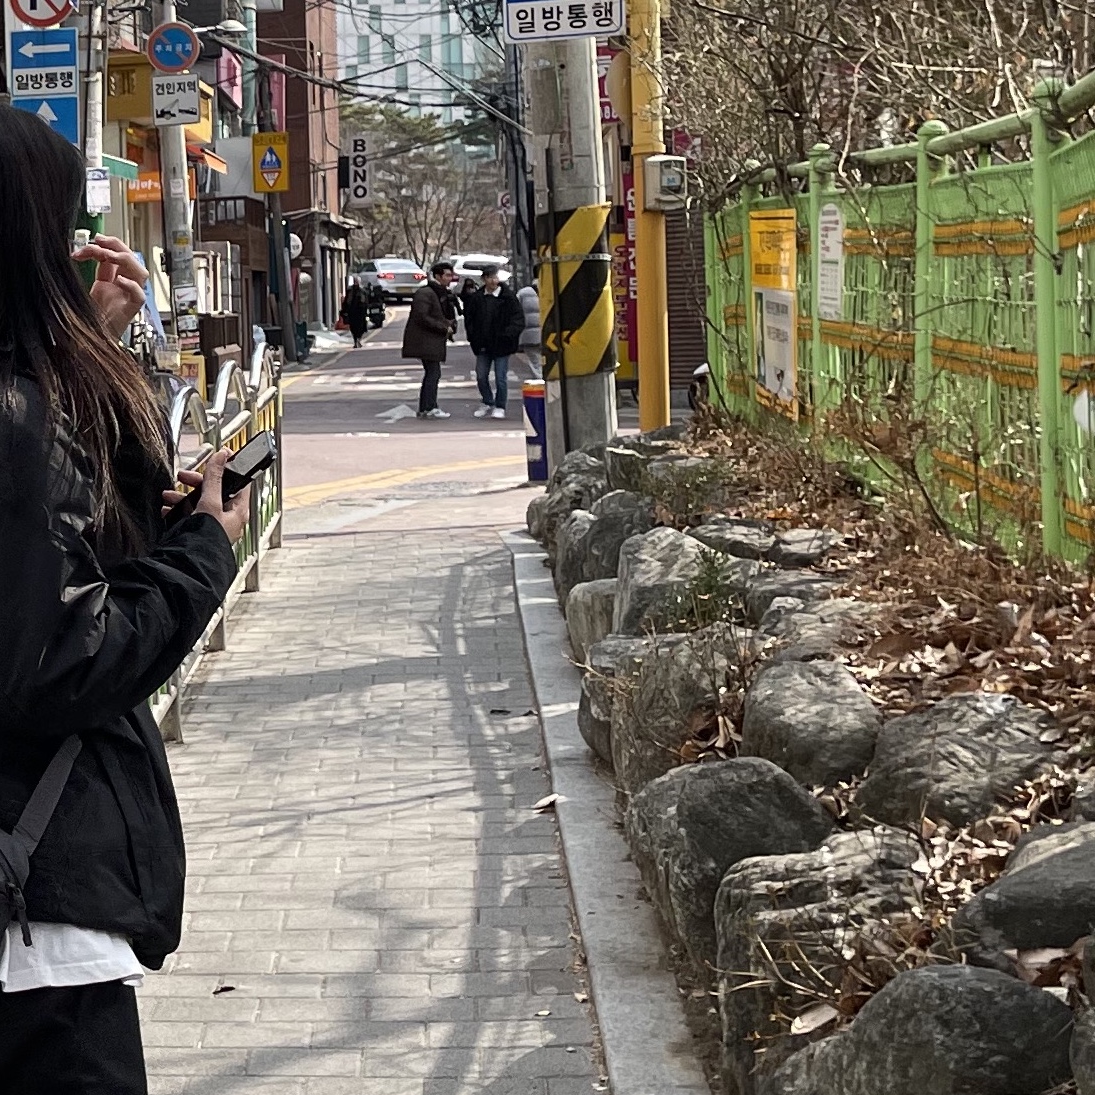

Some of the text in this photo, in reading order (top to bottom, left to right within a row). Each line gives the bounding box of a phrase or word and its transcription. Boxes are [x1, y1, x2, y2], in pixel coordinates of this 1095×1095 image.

[515, 1, 615, 34] 일방통행
[15, 71, 73, 91] 일방통행
[155, 80, 197, 96] 견인지역
[352, 138, 368, 199] BONO
